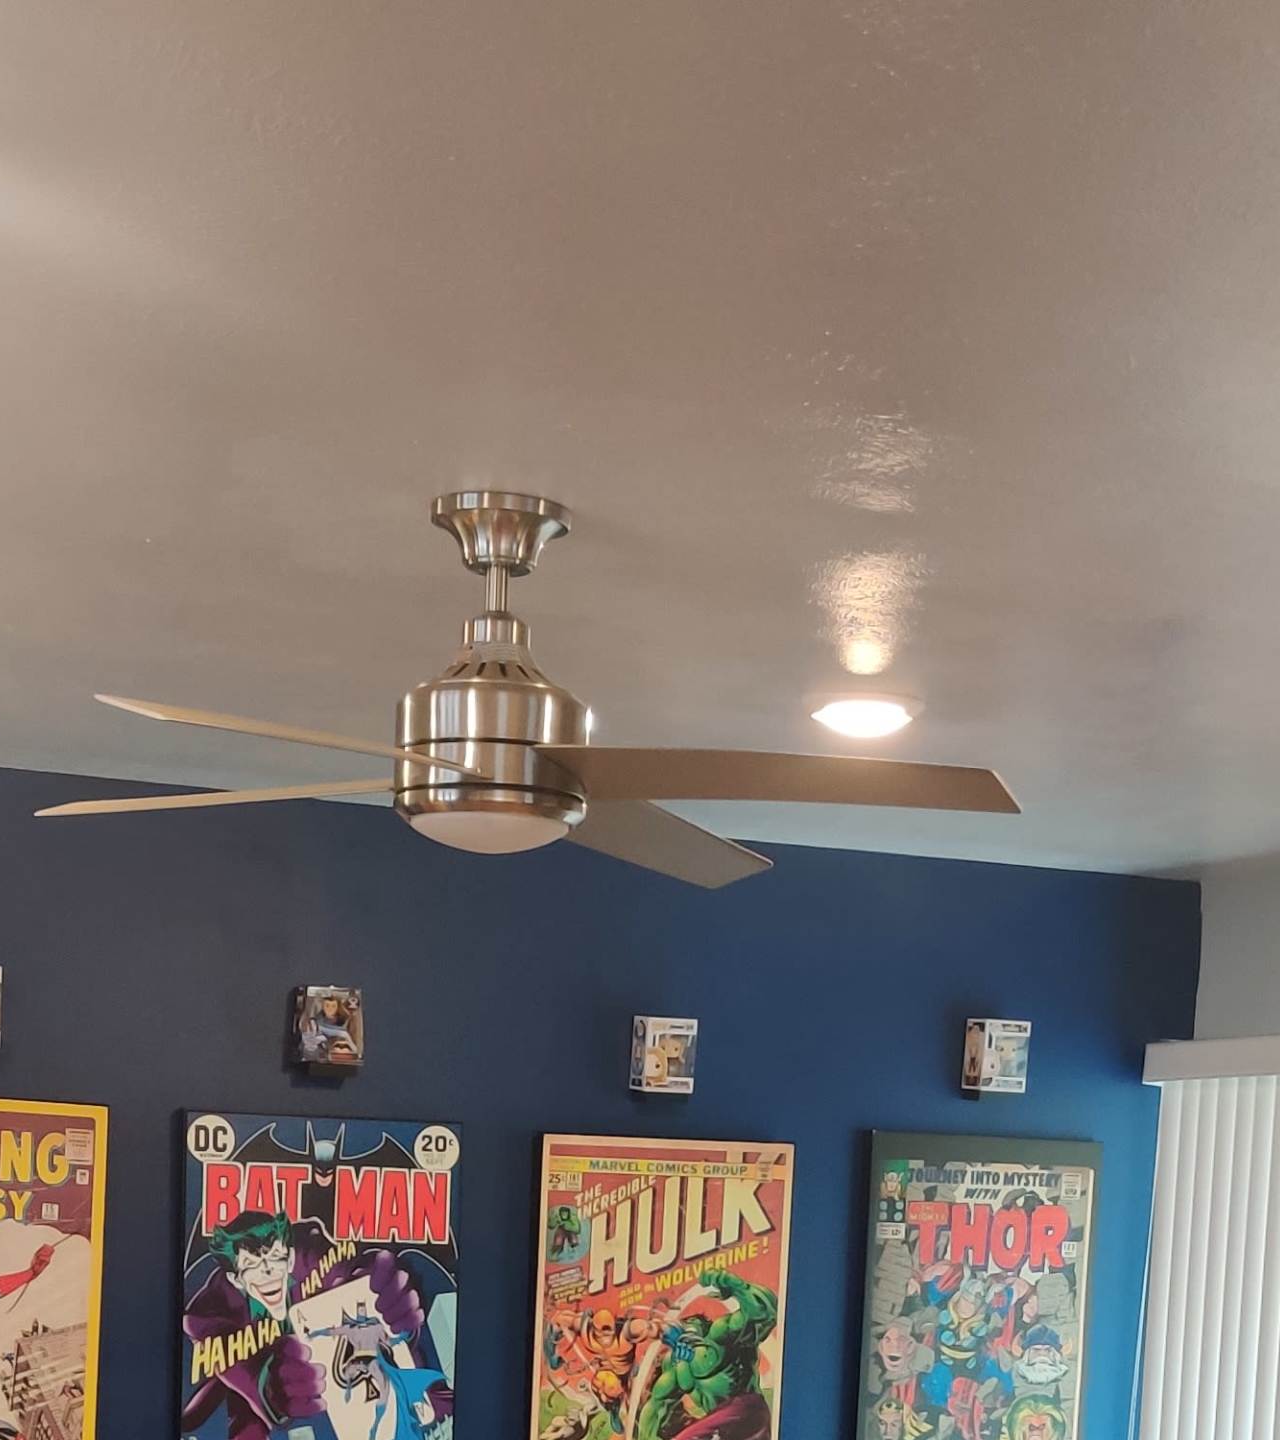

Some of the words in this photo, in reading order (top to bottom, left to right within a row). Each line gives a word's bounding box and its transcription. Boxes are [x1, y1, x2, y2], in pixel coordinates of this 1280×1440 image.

[194, 1125, 228, 1153] DC
[589, 1160, 641, 1172] MARVEL
[647, 1162, 698, 1174] COMICS
[703, 1165, 749, 1176] GROUP
[908, 1168, 967, 1184] JOURNEY
[970, 1170, 1000, 1185] INTO
[1003, 1171, 1061, 1188] MYSTERY
[202, 1161, 312, 1237] BAT
[334, 1165, 451, 1244] MAN
[574, 1183, 602, 1207] THE
[577, 1174, 657, 1218] INCREDIBLE
[964, 1188, 1001, 1199] WITH
[588, 1151, 783, 1294] HULK
[908, 1201, 1071, 1273] THOR
